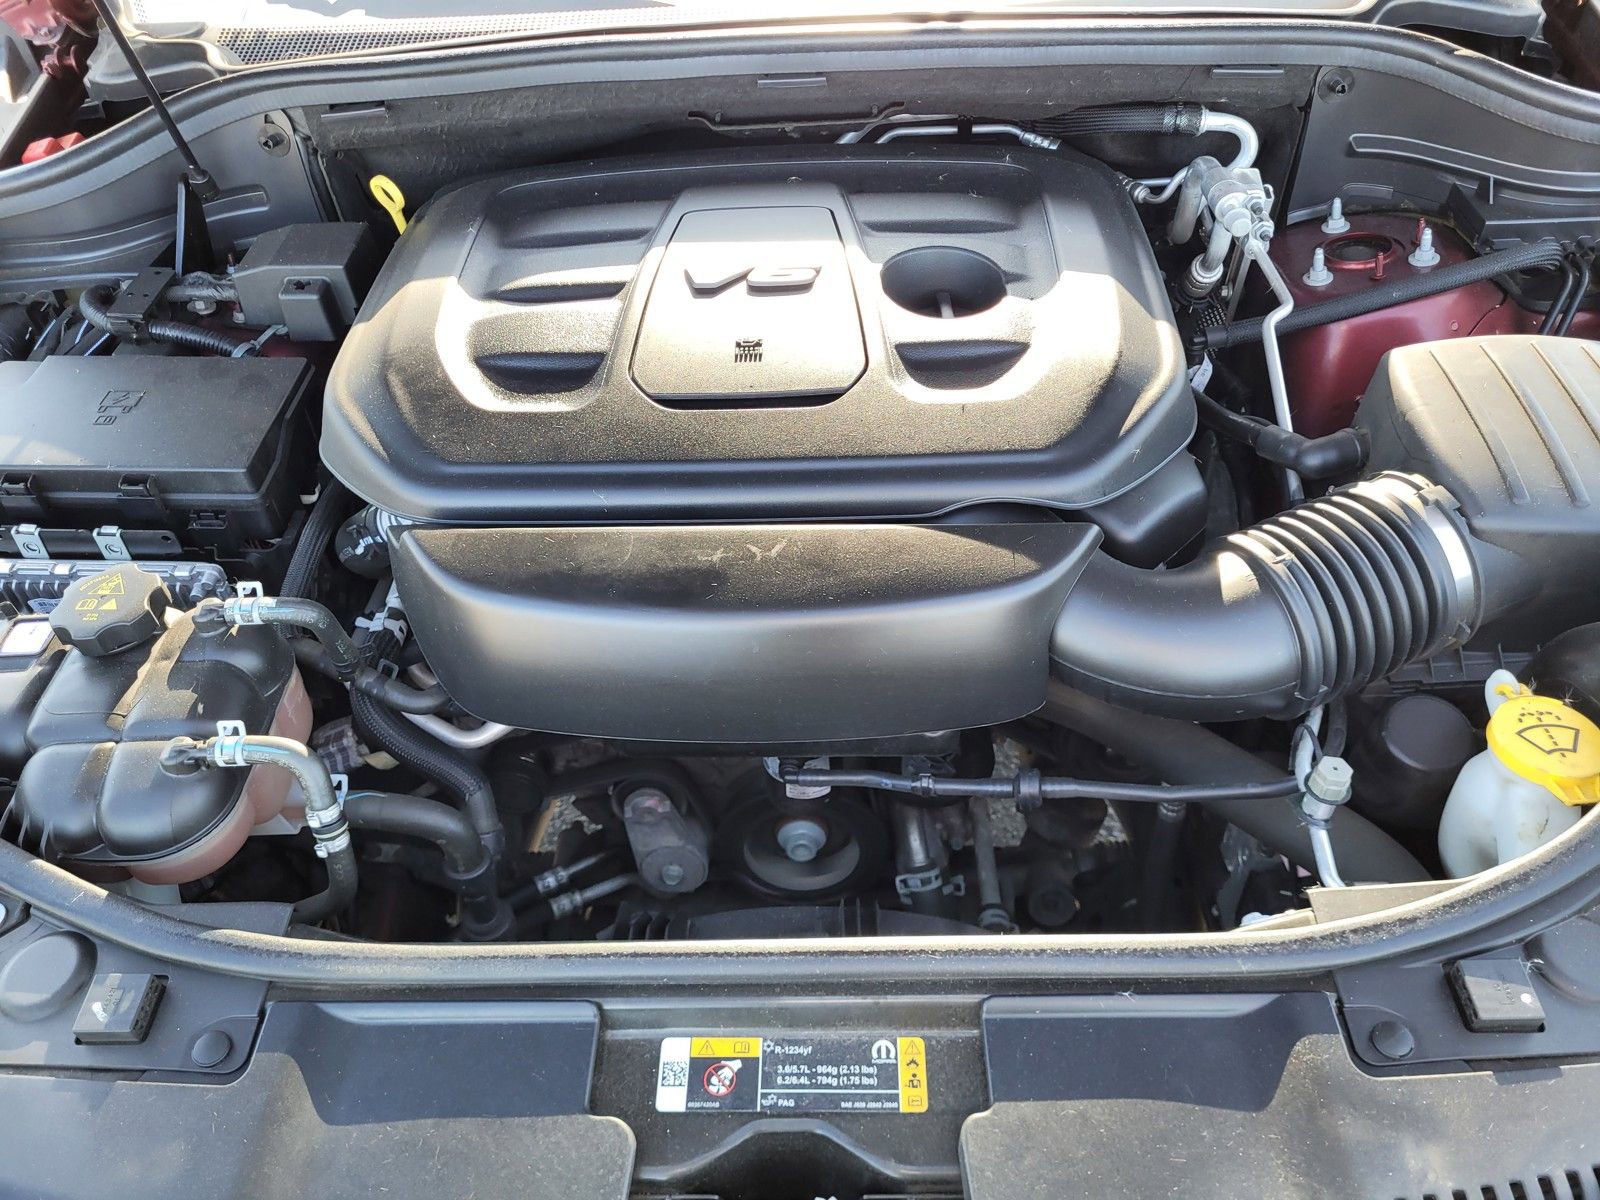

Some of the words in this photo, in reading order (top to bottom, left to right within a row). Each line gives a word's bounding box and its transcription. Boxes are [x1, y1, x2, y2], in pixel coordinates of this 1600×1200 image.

[774, 1045, 813, 1057] R-1234yf
[776, 1064, 811, 1075] 3.6/5.7L
[816, 1064, 838, 1076] 964g
[839, 1064, 859, 1075] (2.13
[860, 1064, 878, 1075] lbs)
[776, 1075, 811, 1086] 6.2/6.4L
[817, 1075, 838, 1087] 794g
[839, 1075, 859, 1086] (1.75
[860, 1075, 878, 1086] lbs)
[777, 1099, 795, 1108] PAG
